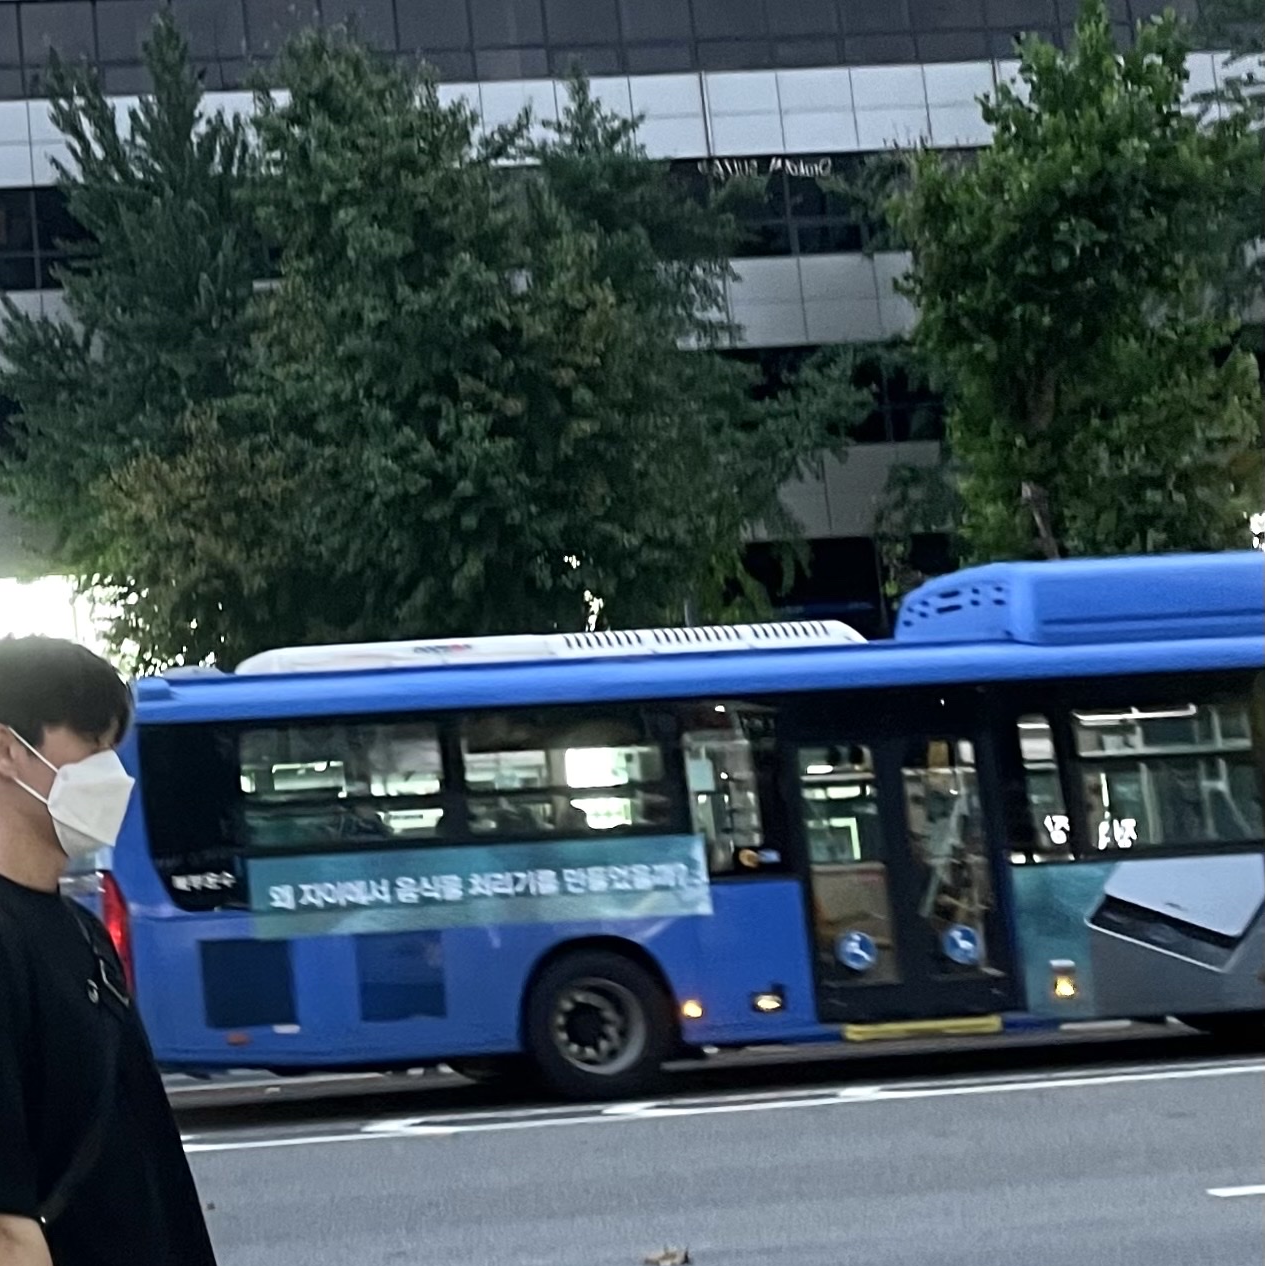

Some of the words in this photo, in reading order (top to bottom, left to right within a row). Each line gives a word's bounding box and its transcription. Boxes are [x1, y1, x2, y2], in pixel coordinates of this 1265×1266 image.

[269, 884, 296, 911] 왜
[394, 873, 464, 904] 음식물
[468, 868, 560, 897] 처리기를
